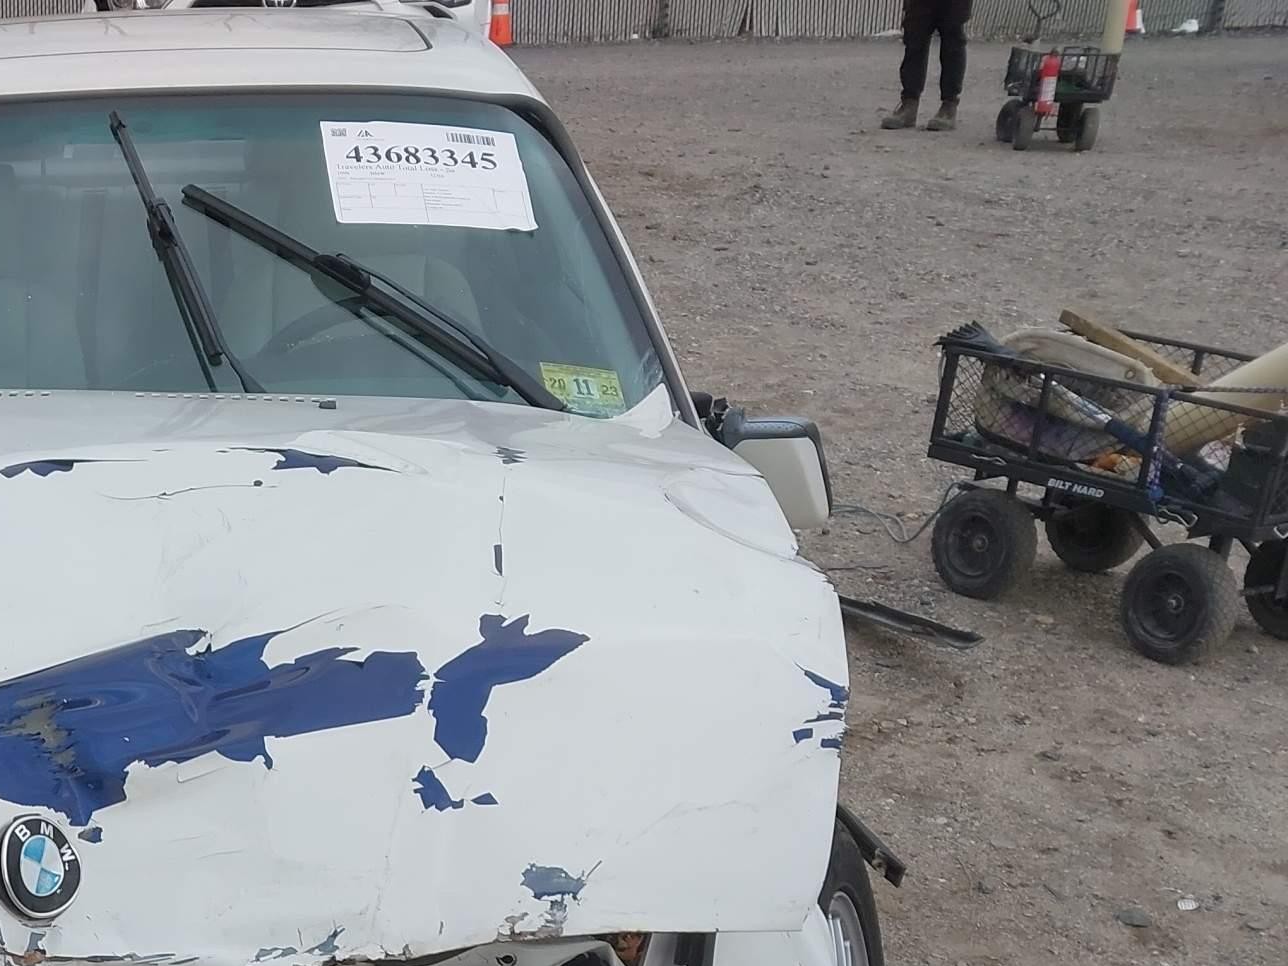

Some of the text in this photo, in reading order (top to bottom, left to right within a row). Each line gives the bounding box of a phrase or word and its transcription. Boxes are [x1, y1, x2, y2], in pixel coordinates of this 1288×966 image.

[345, 144, 498, 171] 43683345
[573, 378, 594, 396] 11
[601, 384, 619, 397] 23
[1048, 478, 1104, 497] BILT HARD
[15, 821, 75, 862] BMW
